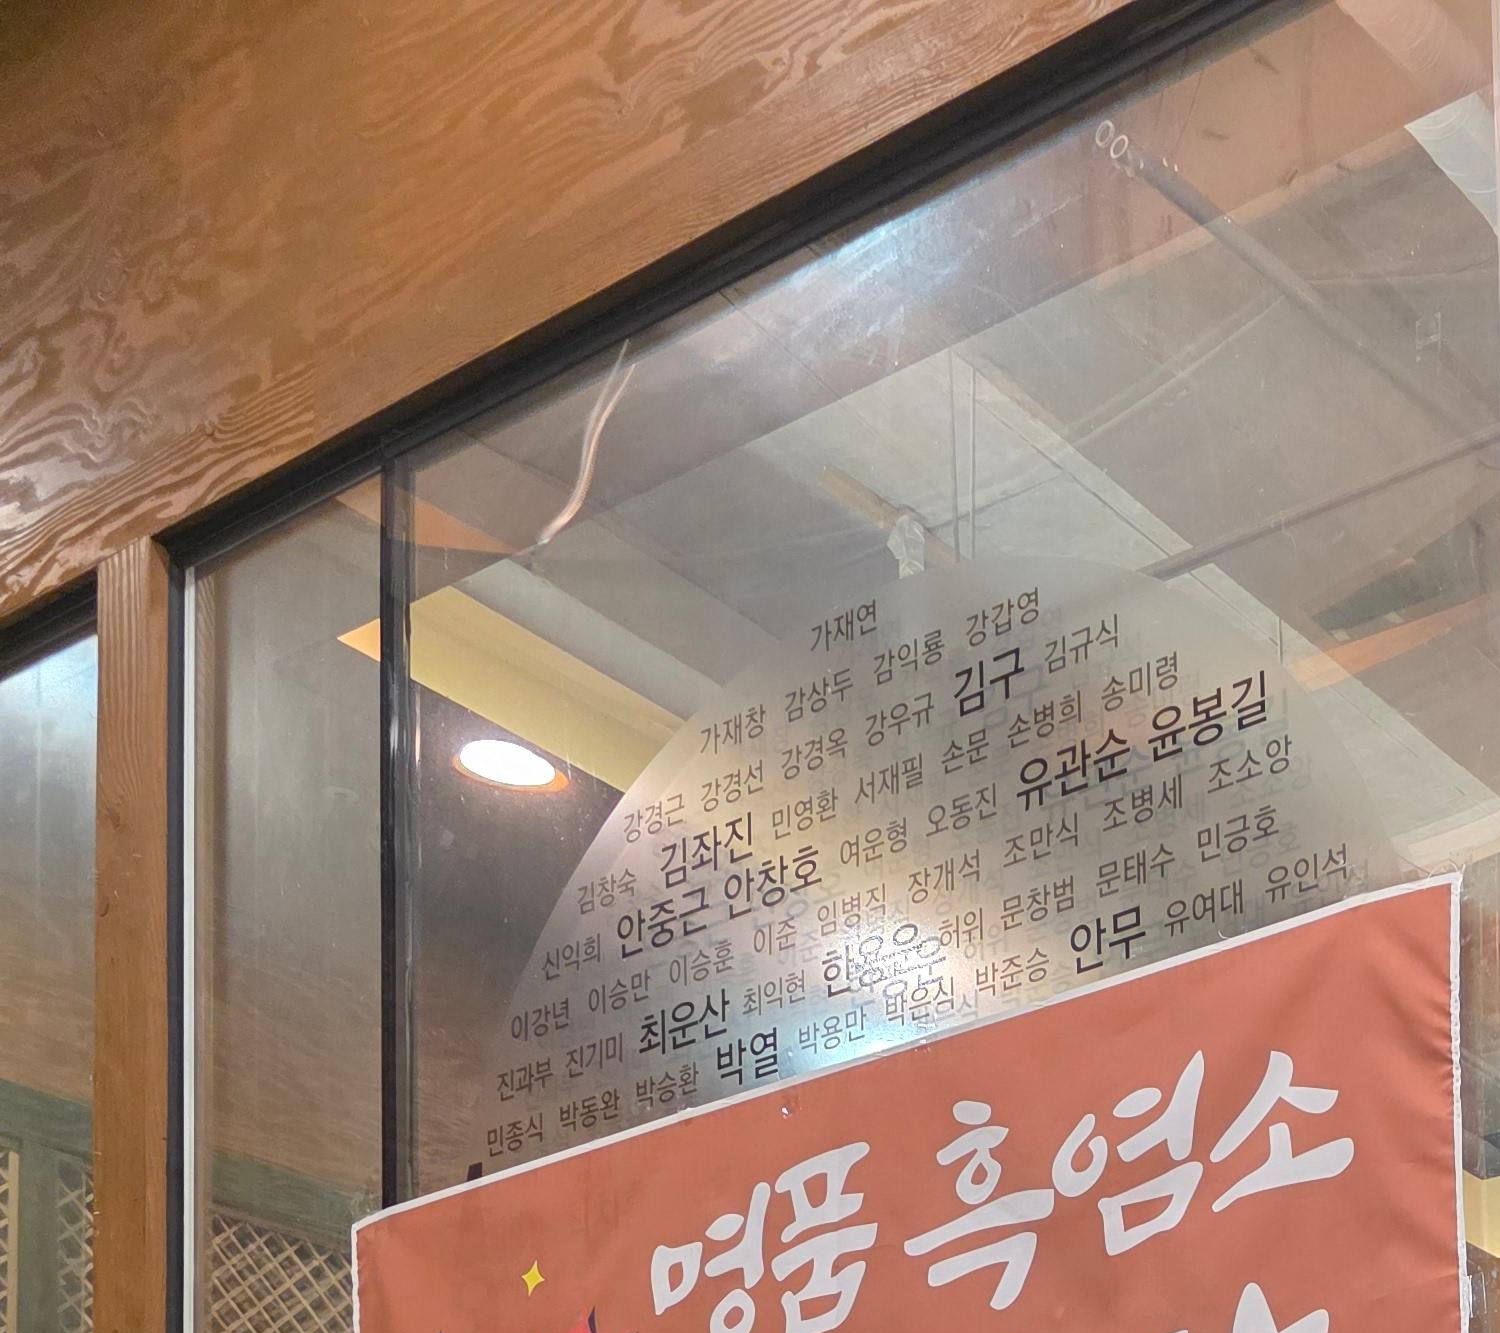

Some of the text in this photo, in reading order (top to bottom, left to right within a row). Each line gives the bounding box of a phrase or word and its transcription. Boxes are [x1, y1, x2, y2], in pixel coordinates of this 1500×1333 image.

[624, 614, 1120, 842] 강경근 강경선 강경옥 강우규 김구 김규식
[700, 705, 766, 755] 가재창
[965, 587, 1041, 647] 강갑영
[810, 598, 877, 653] 가재연
[511, 734, 1293, 1041] 이강년 이승만 이승훈 이준 임병직 장개석 조만식 조병세 조소앙
[542, 670, 1268, 981] 신익희 안중근 안창호 여운형 오동진 유관순 윤봉길
[577, 652, 1179, 915] 김창숙 김좌진 민영환 서재필 손문 손병희 송미령
[487, 843, 1349, 1157] 민종식 박동완 박승환 박열 박용만 박은식 박준승 안무 유여대 유인석
[497, 1057, 553, 1102] 진과부
[566, 1032, 623, 1079] 진기미
[639, 988, 731, 1056] 최운산
[742, 969, 806, 1016] 최익현
[938, 908, 984, 949] 허위
[1000, 875, 1076, 933] 문창범
[1097, 843, 1176, 897] 문태수
[1197, 805, 1279, 862] 민긍호
[904, 1050, 1356, 1312] 흑염소
